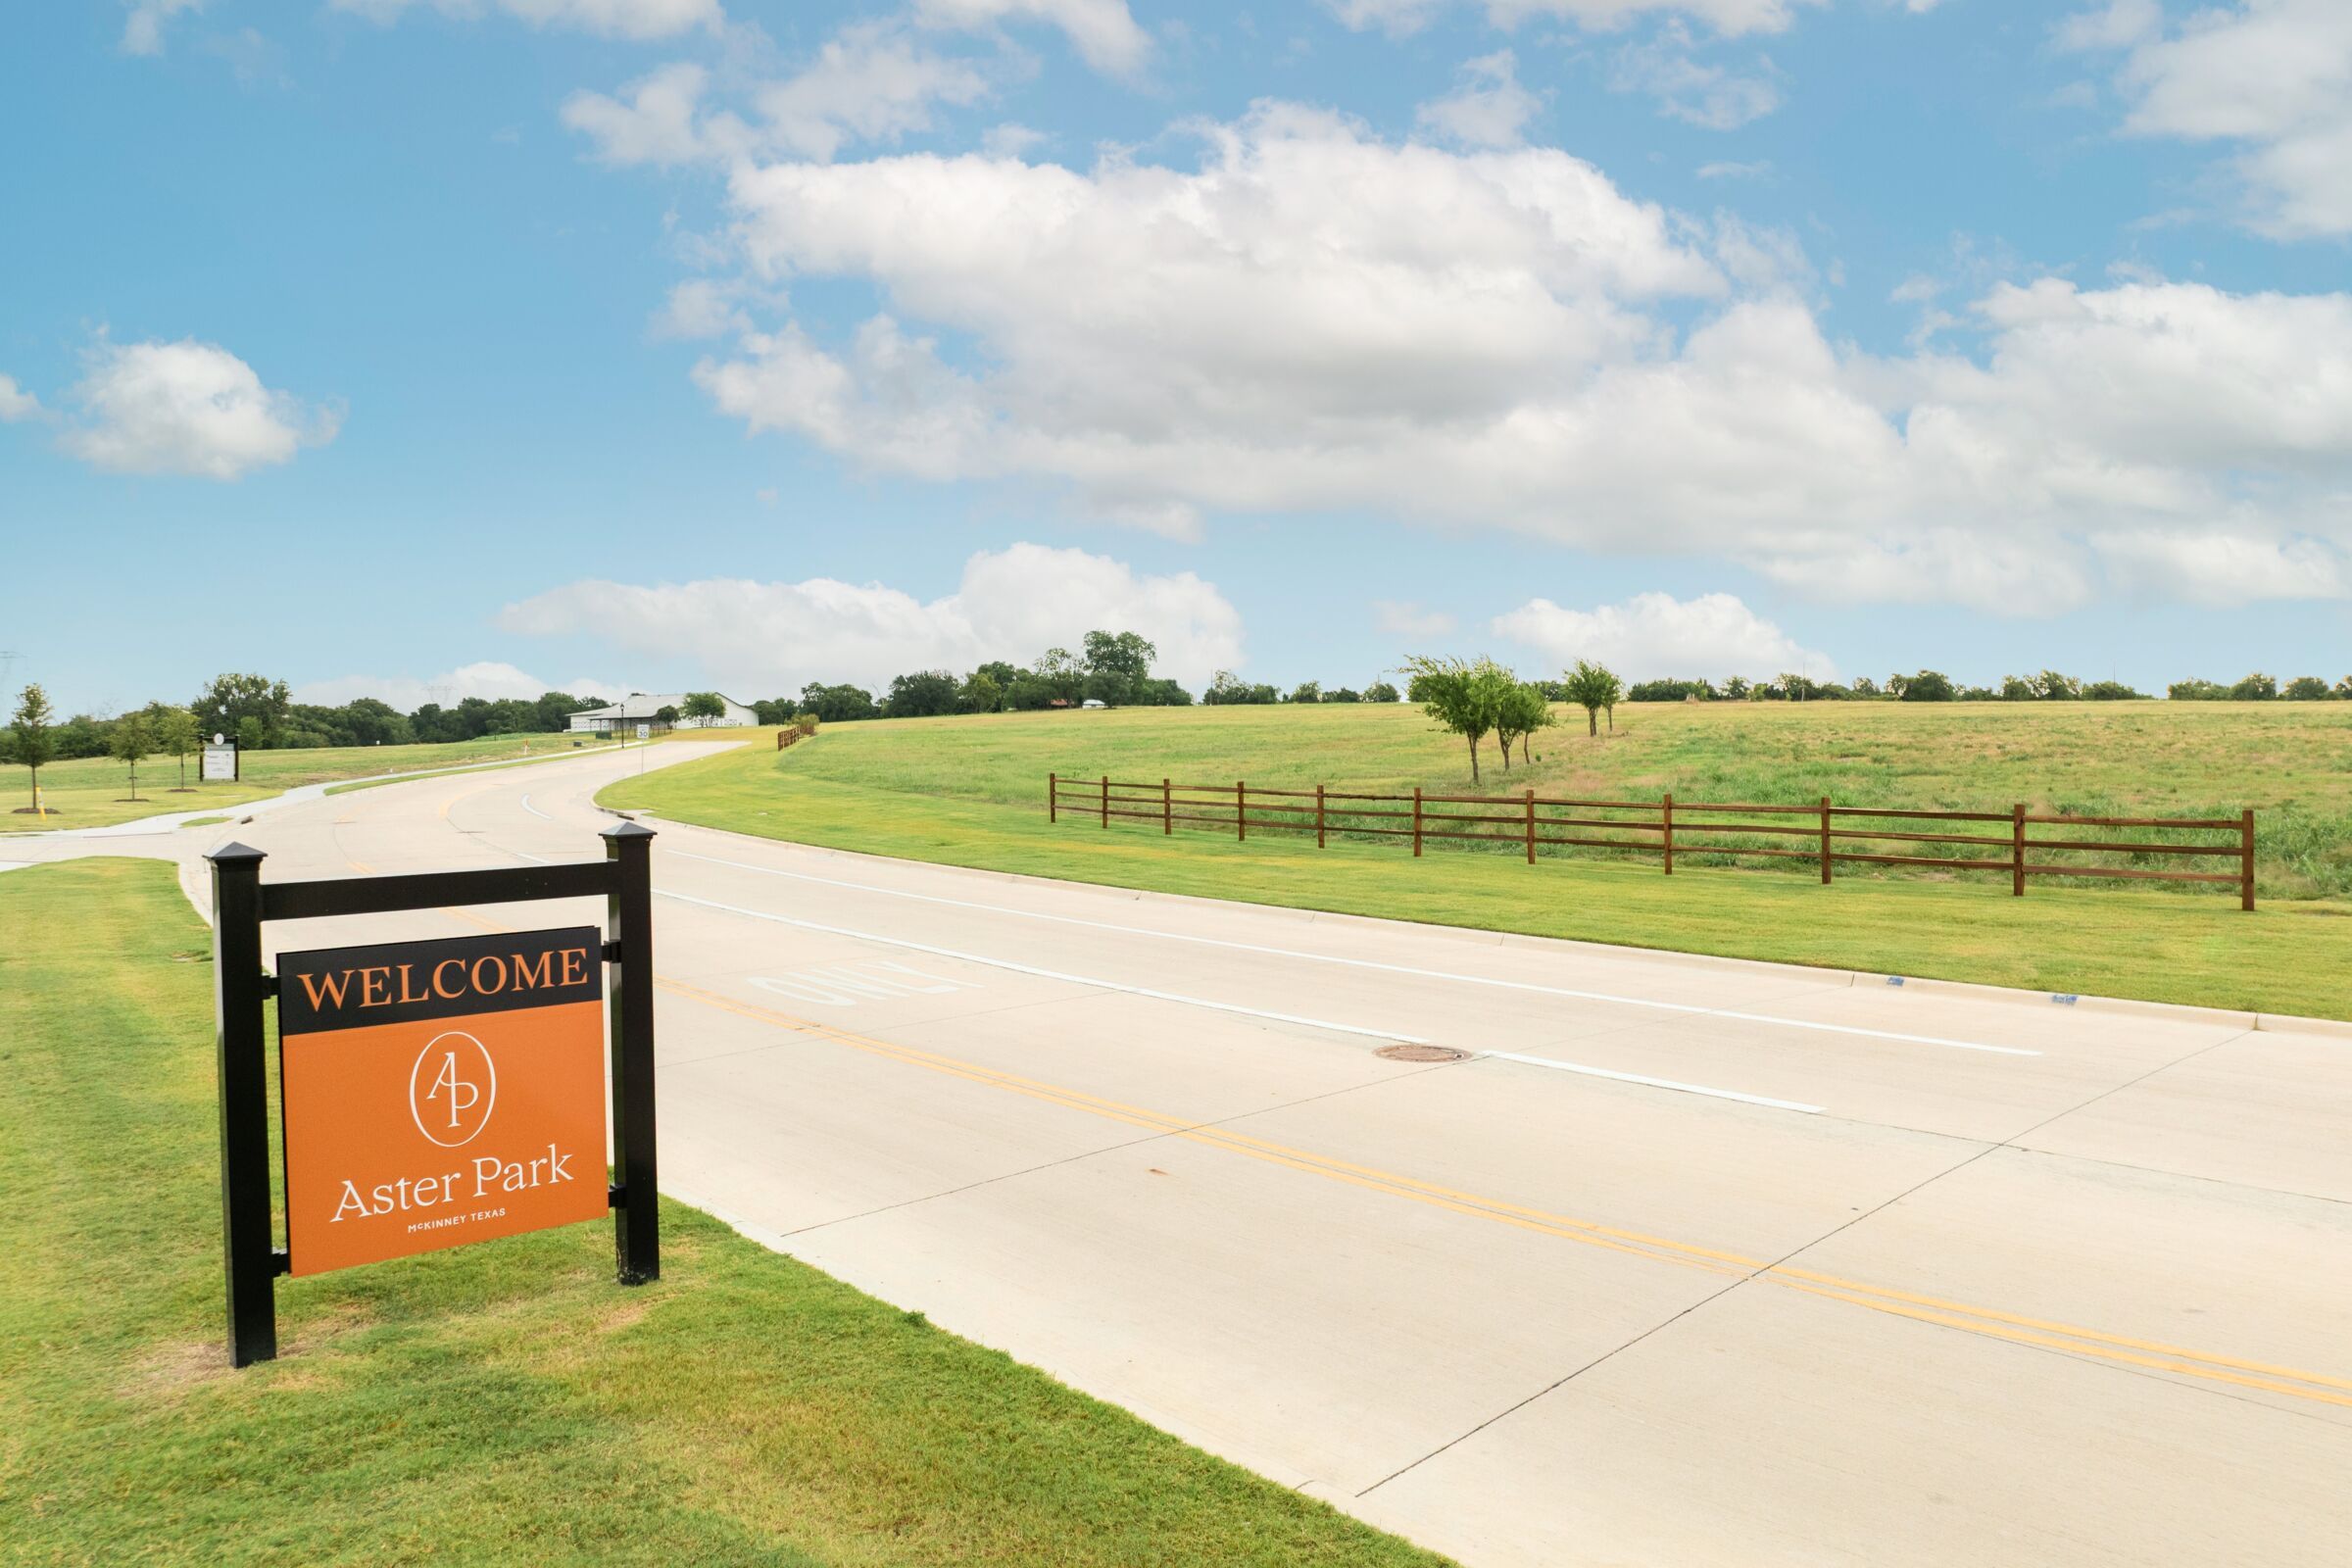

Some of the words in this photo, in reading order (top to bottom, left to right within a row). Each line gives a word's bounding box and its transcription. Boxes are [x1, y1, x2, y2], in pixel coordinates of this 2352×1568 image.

[297, 948, 588, 1012] WELCOME
[746, 960, 987, 1006] ONLY
[330, 1172, 462, 1223] Aster
[471, 1144, 574, 1197] Park
[470, 1207, 506, 1221] TEXAS
